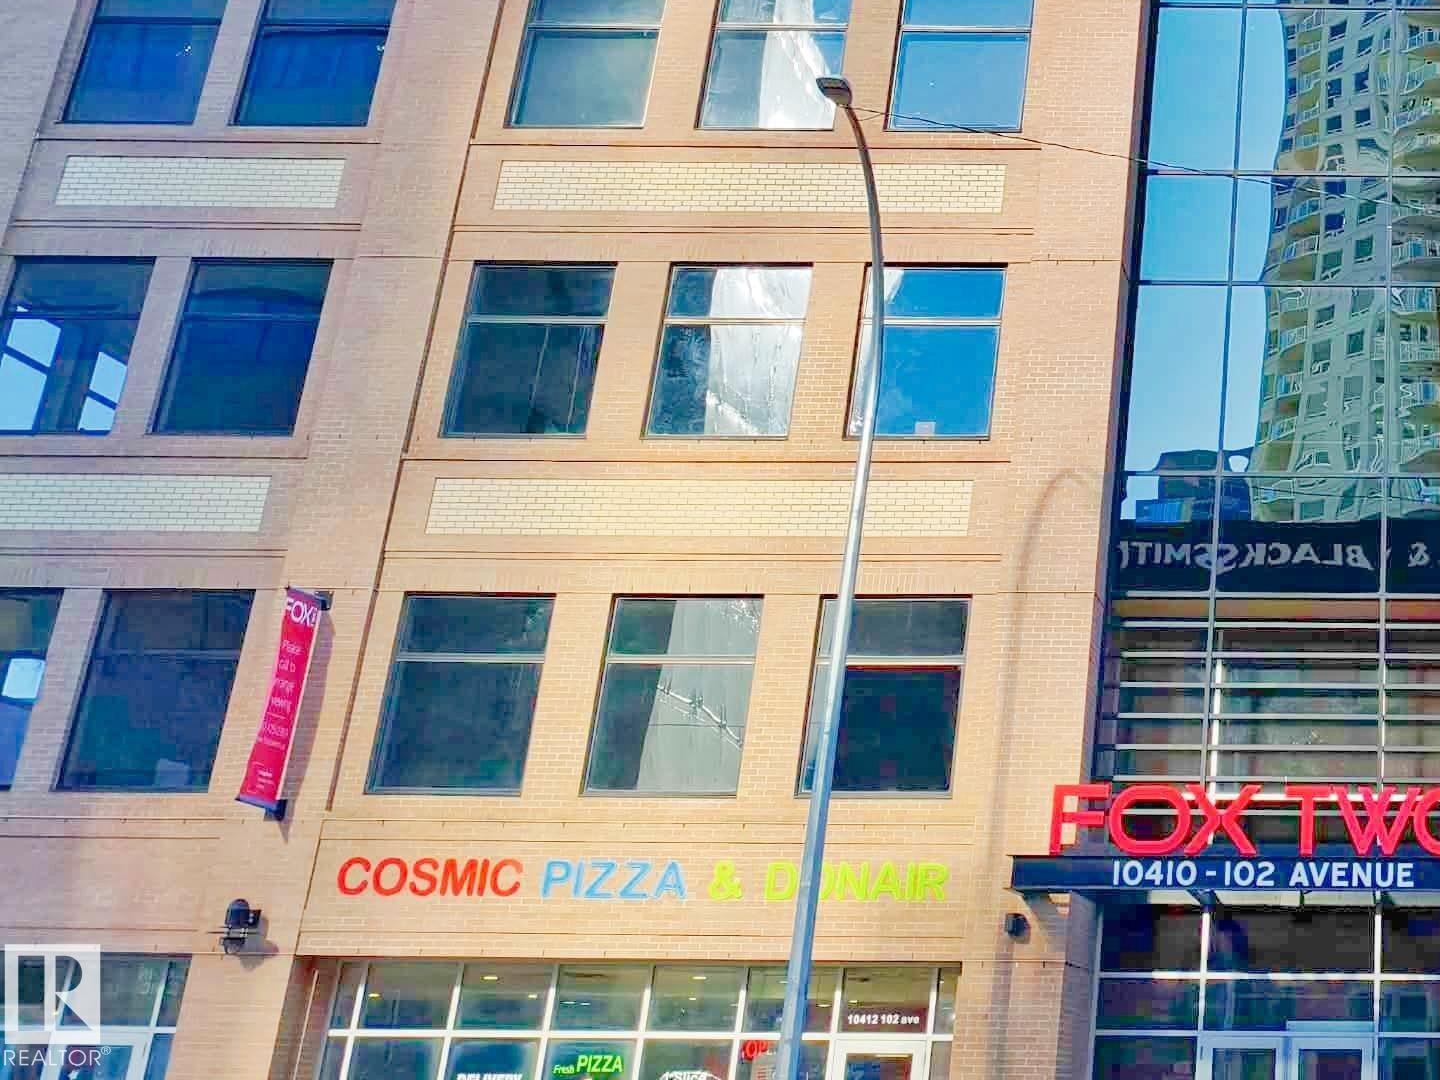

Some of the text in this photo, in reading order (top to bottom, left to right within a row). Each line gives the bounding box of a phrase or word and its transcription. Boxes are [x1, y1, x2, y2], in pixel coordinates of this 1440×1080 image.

[1049, 783, 1258, 857] FOX
[336, 856, 524, 897] COSMIC
[541, 859, 688, 898] PIZZA
[708, 859, 742, 900] &
[1112, 860, 1198, 886] 10410
[1223, 860, 1275, 887] 102
[1288, 862, 1415, 888] AVENUE
[848, 1014, 879, 1025] 10412
[880, 1014, 899, 1025] 102
[576, 1055, 623, 1073] PIZZA
